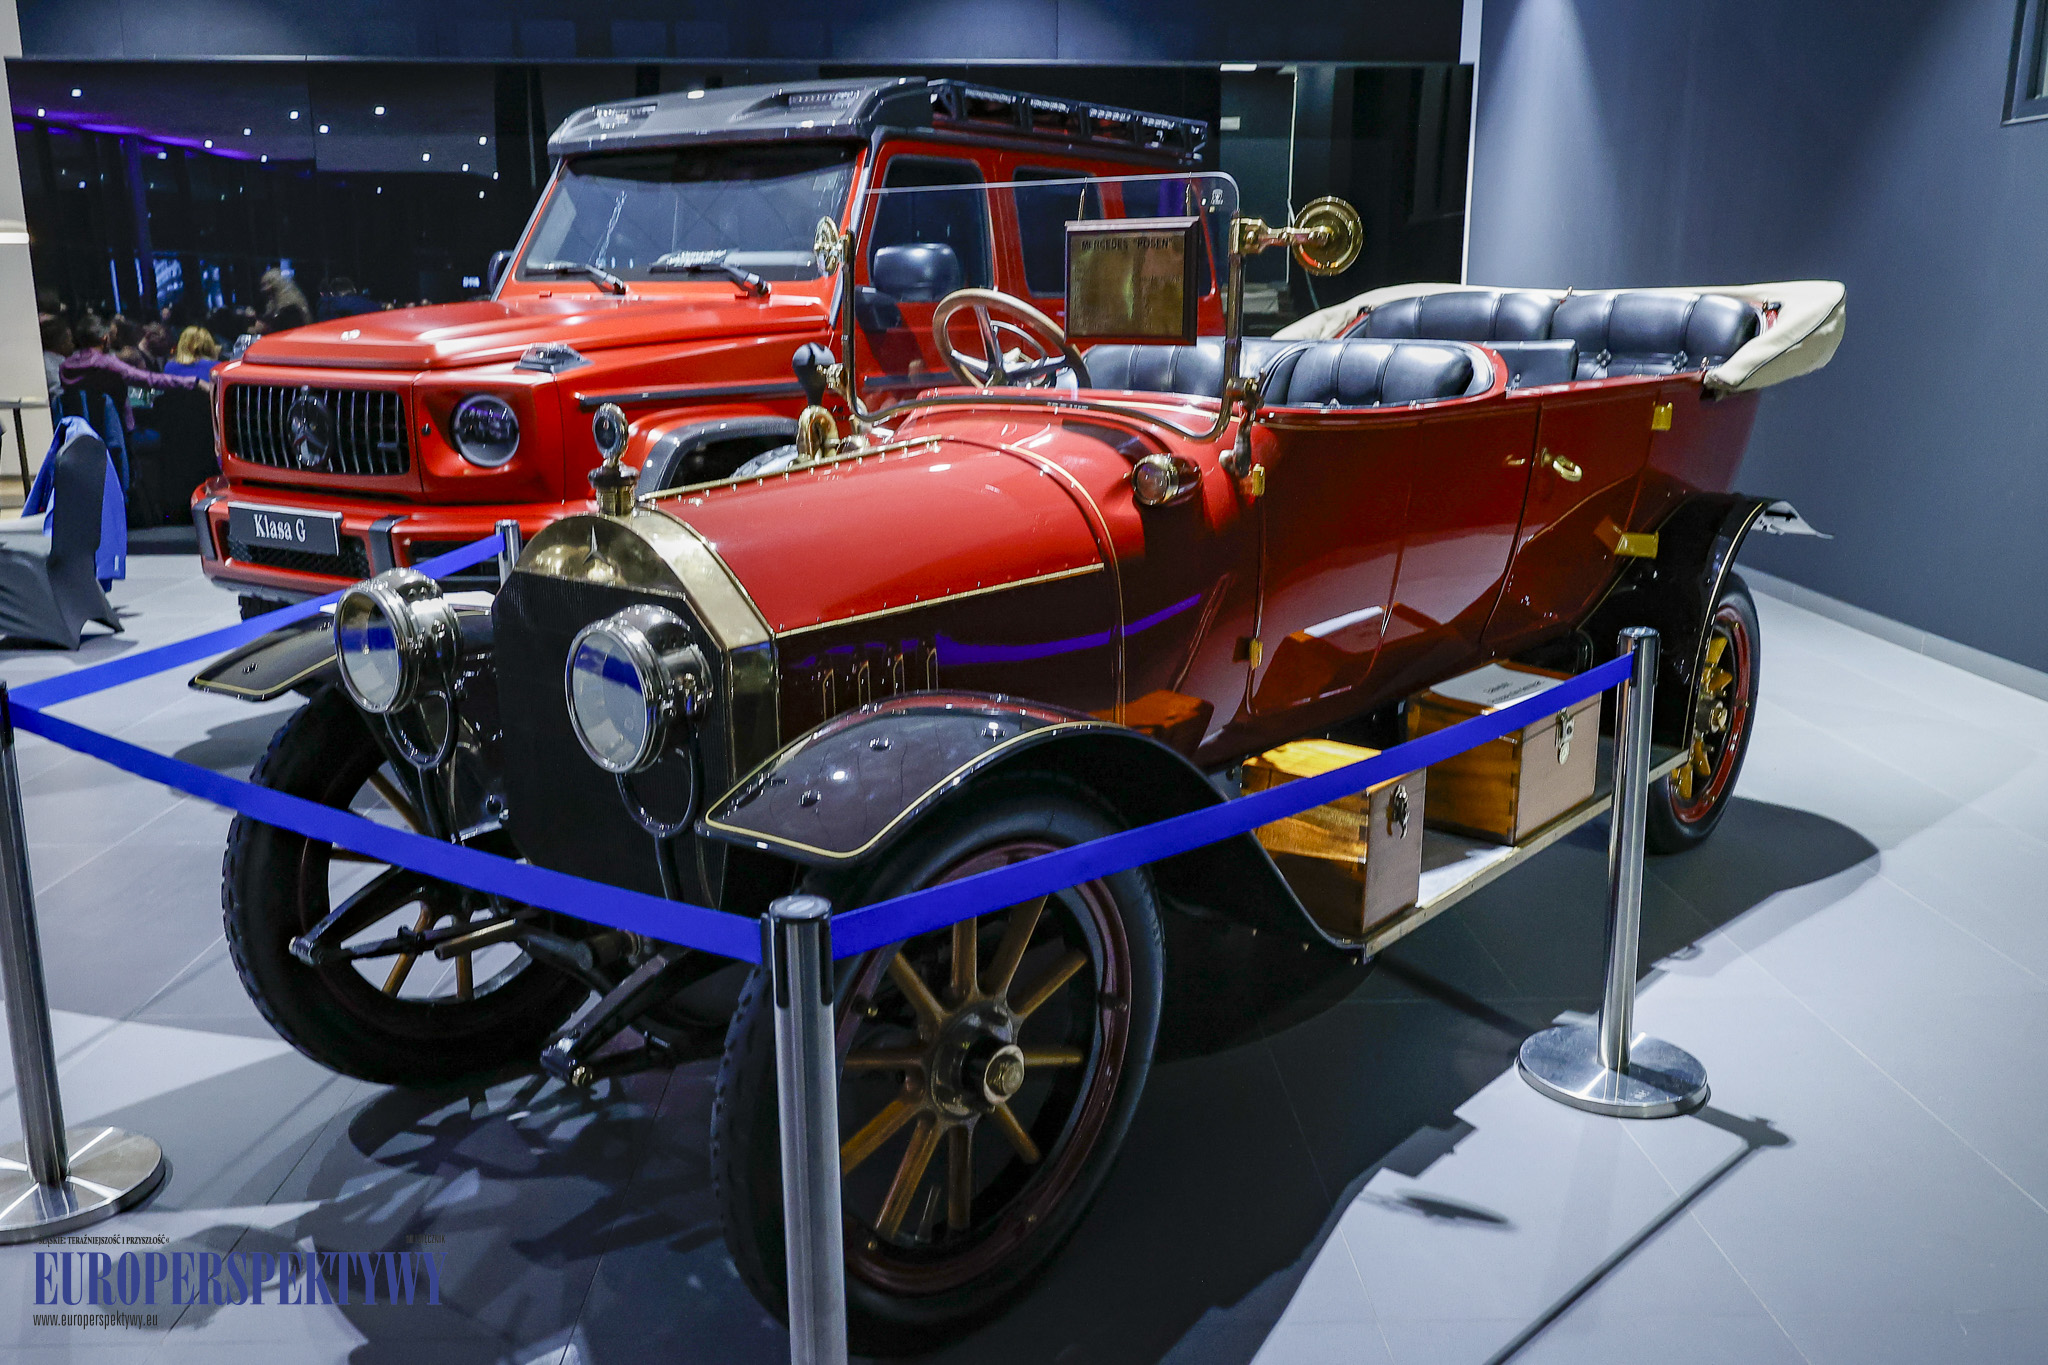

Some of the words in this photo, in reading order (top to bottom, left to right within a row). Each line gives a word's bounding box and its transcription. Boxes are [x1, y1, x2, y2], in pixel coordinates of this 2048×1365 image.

[1081, 239, 1128, 250] MERCEDES
[253, 513, 293, 541] Klasa
[295, 518, 306, 542] G
